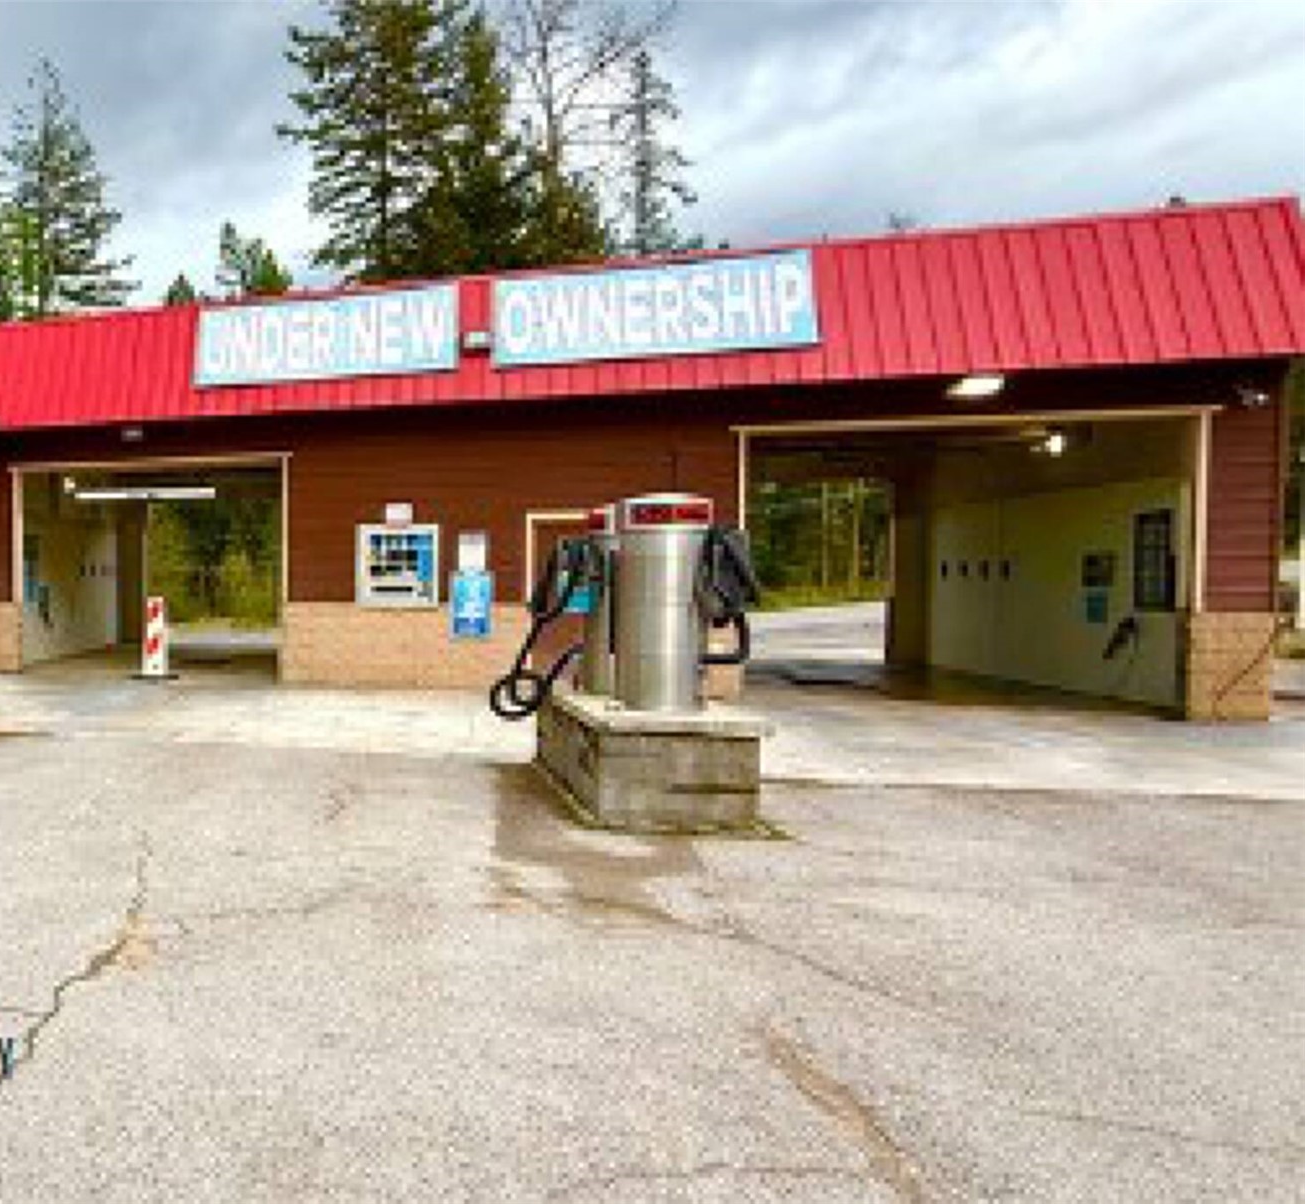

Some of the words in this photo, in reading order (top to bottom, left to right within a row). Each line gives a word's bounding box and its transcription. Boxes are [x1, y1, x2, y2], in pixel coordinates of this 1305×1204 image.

[201, 304, 338, 372] UNDER
[354, 290, 447, 366] NEW
[502, 262, 803, 354] OWNERSHIP
